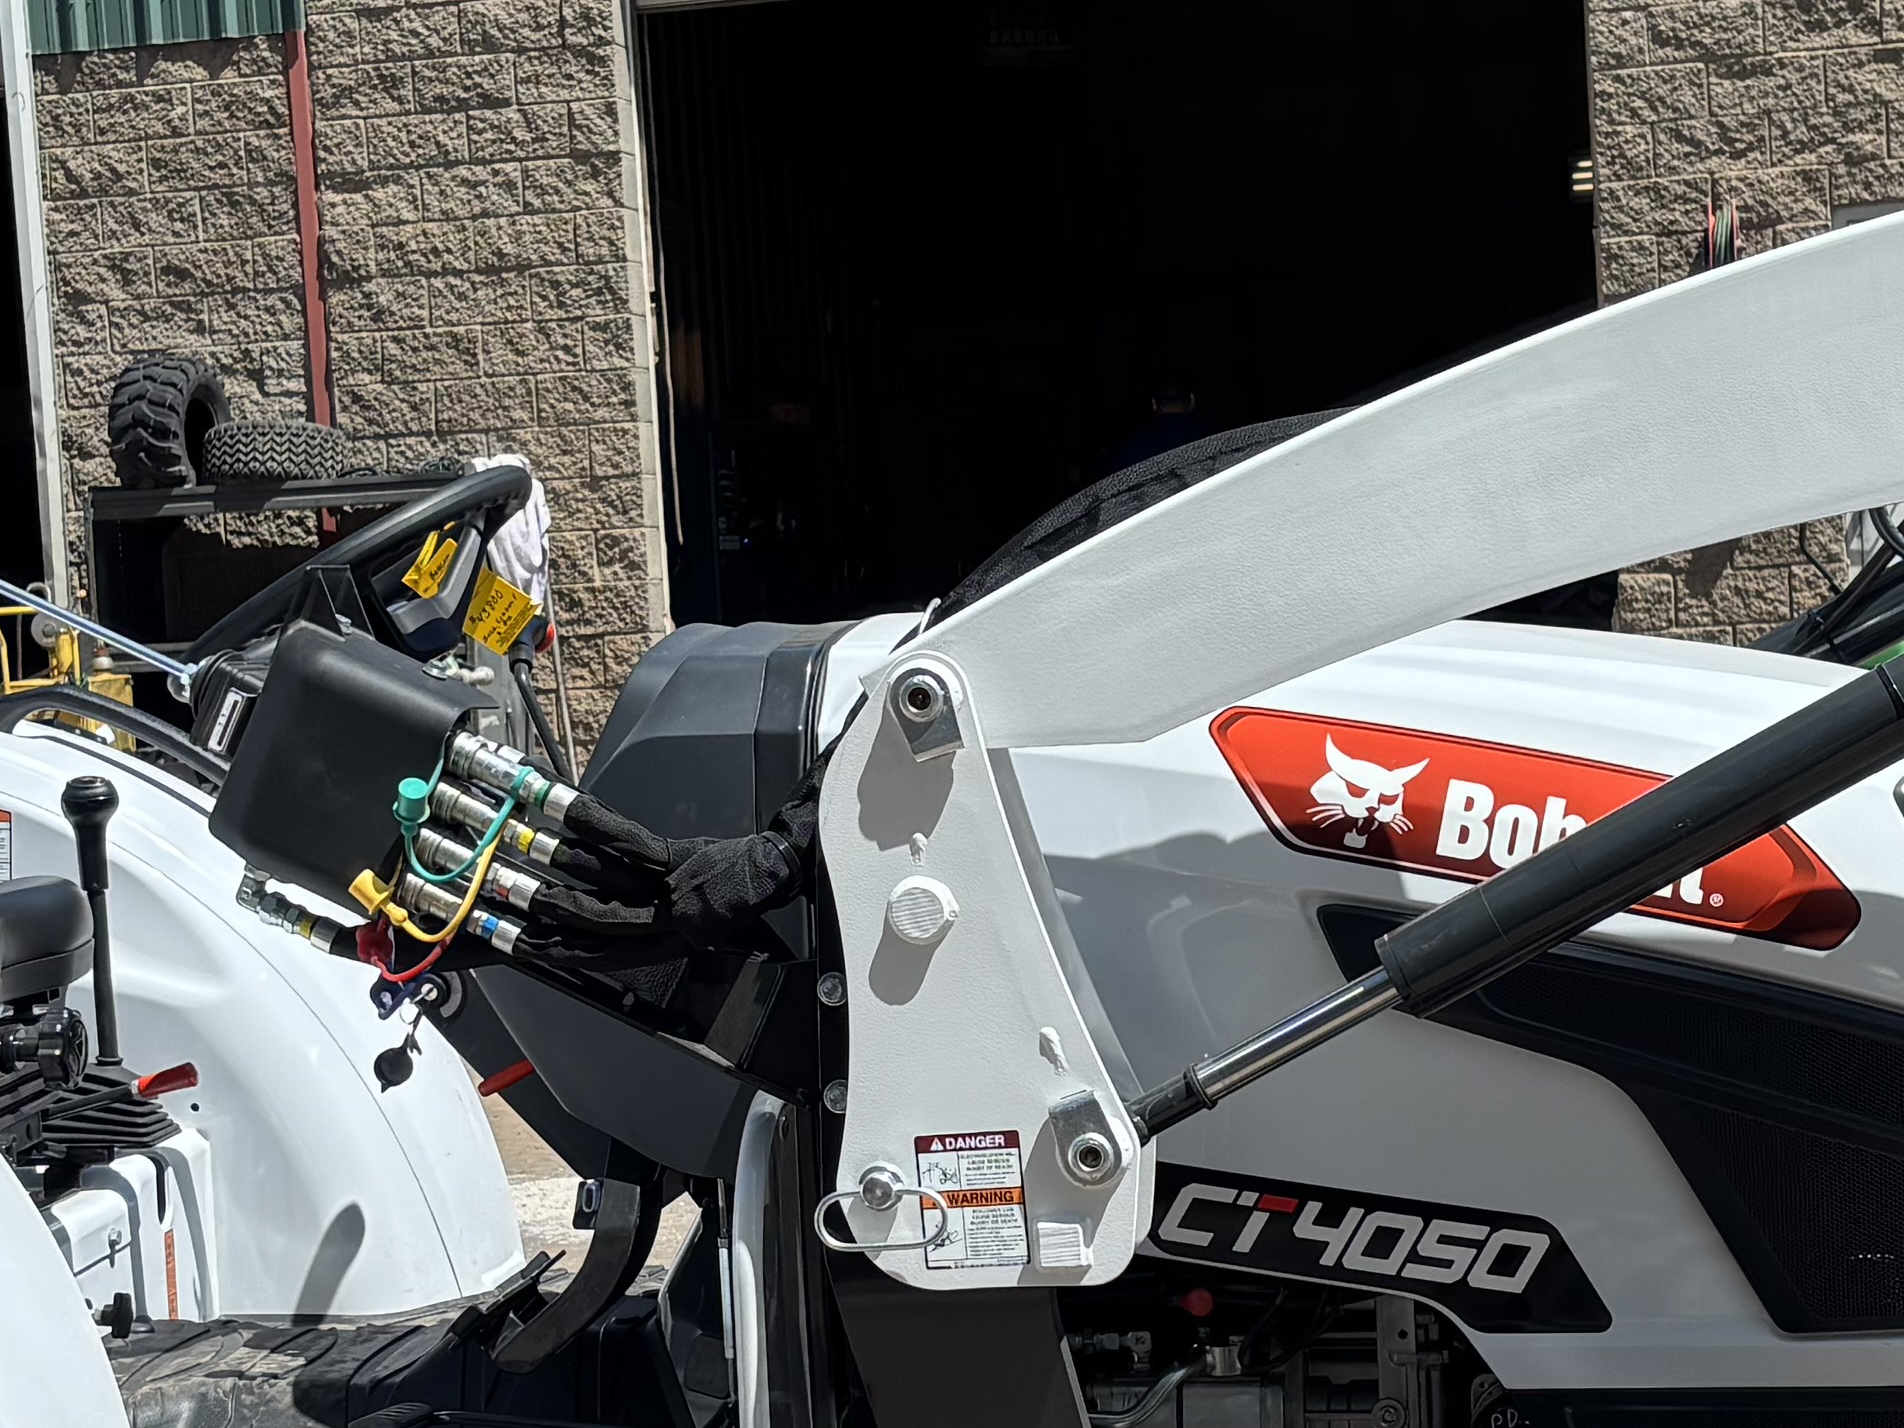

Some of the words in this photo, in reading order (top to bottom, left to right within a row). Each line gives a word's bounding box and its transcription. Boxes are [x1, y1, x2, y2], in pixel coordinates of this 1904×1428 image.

[945, 1134, 1005, 1150] DANGER
[947, 1190, 1014, 1206] WARNING
[1157, 1183, 1551, 1294] CT4050
